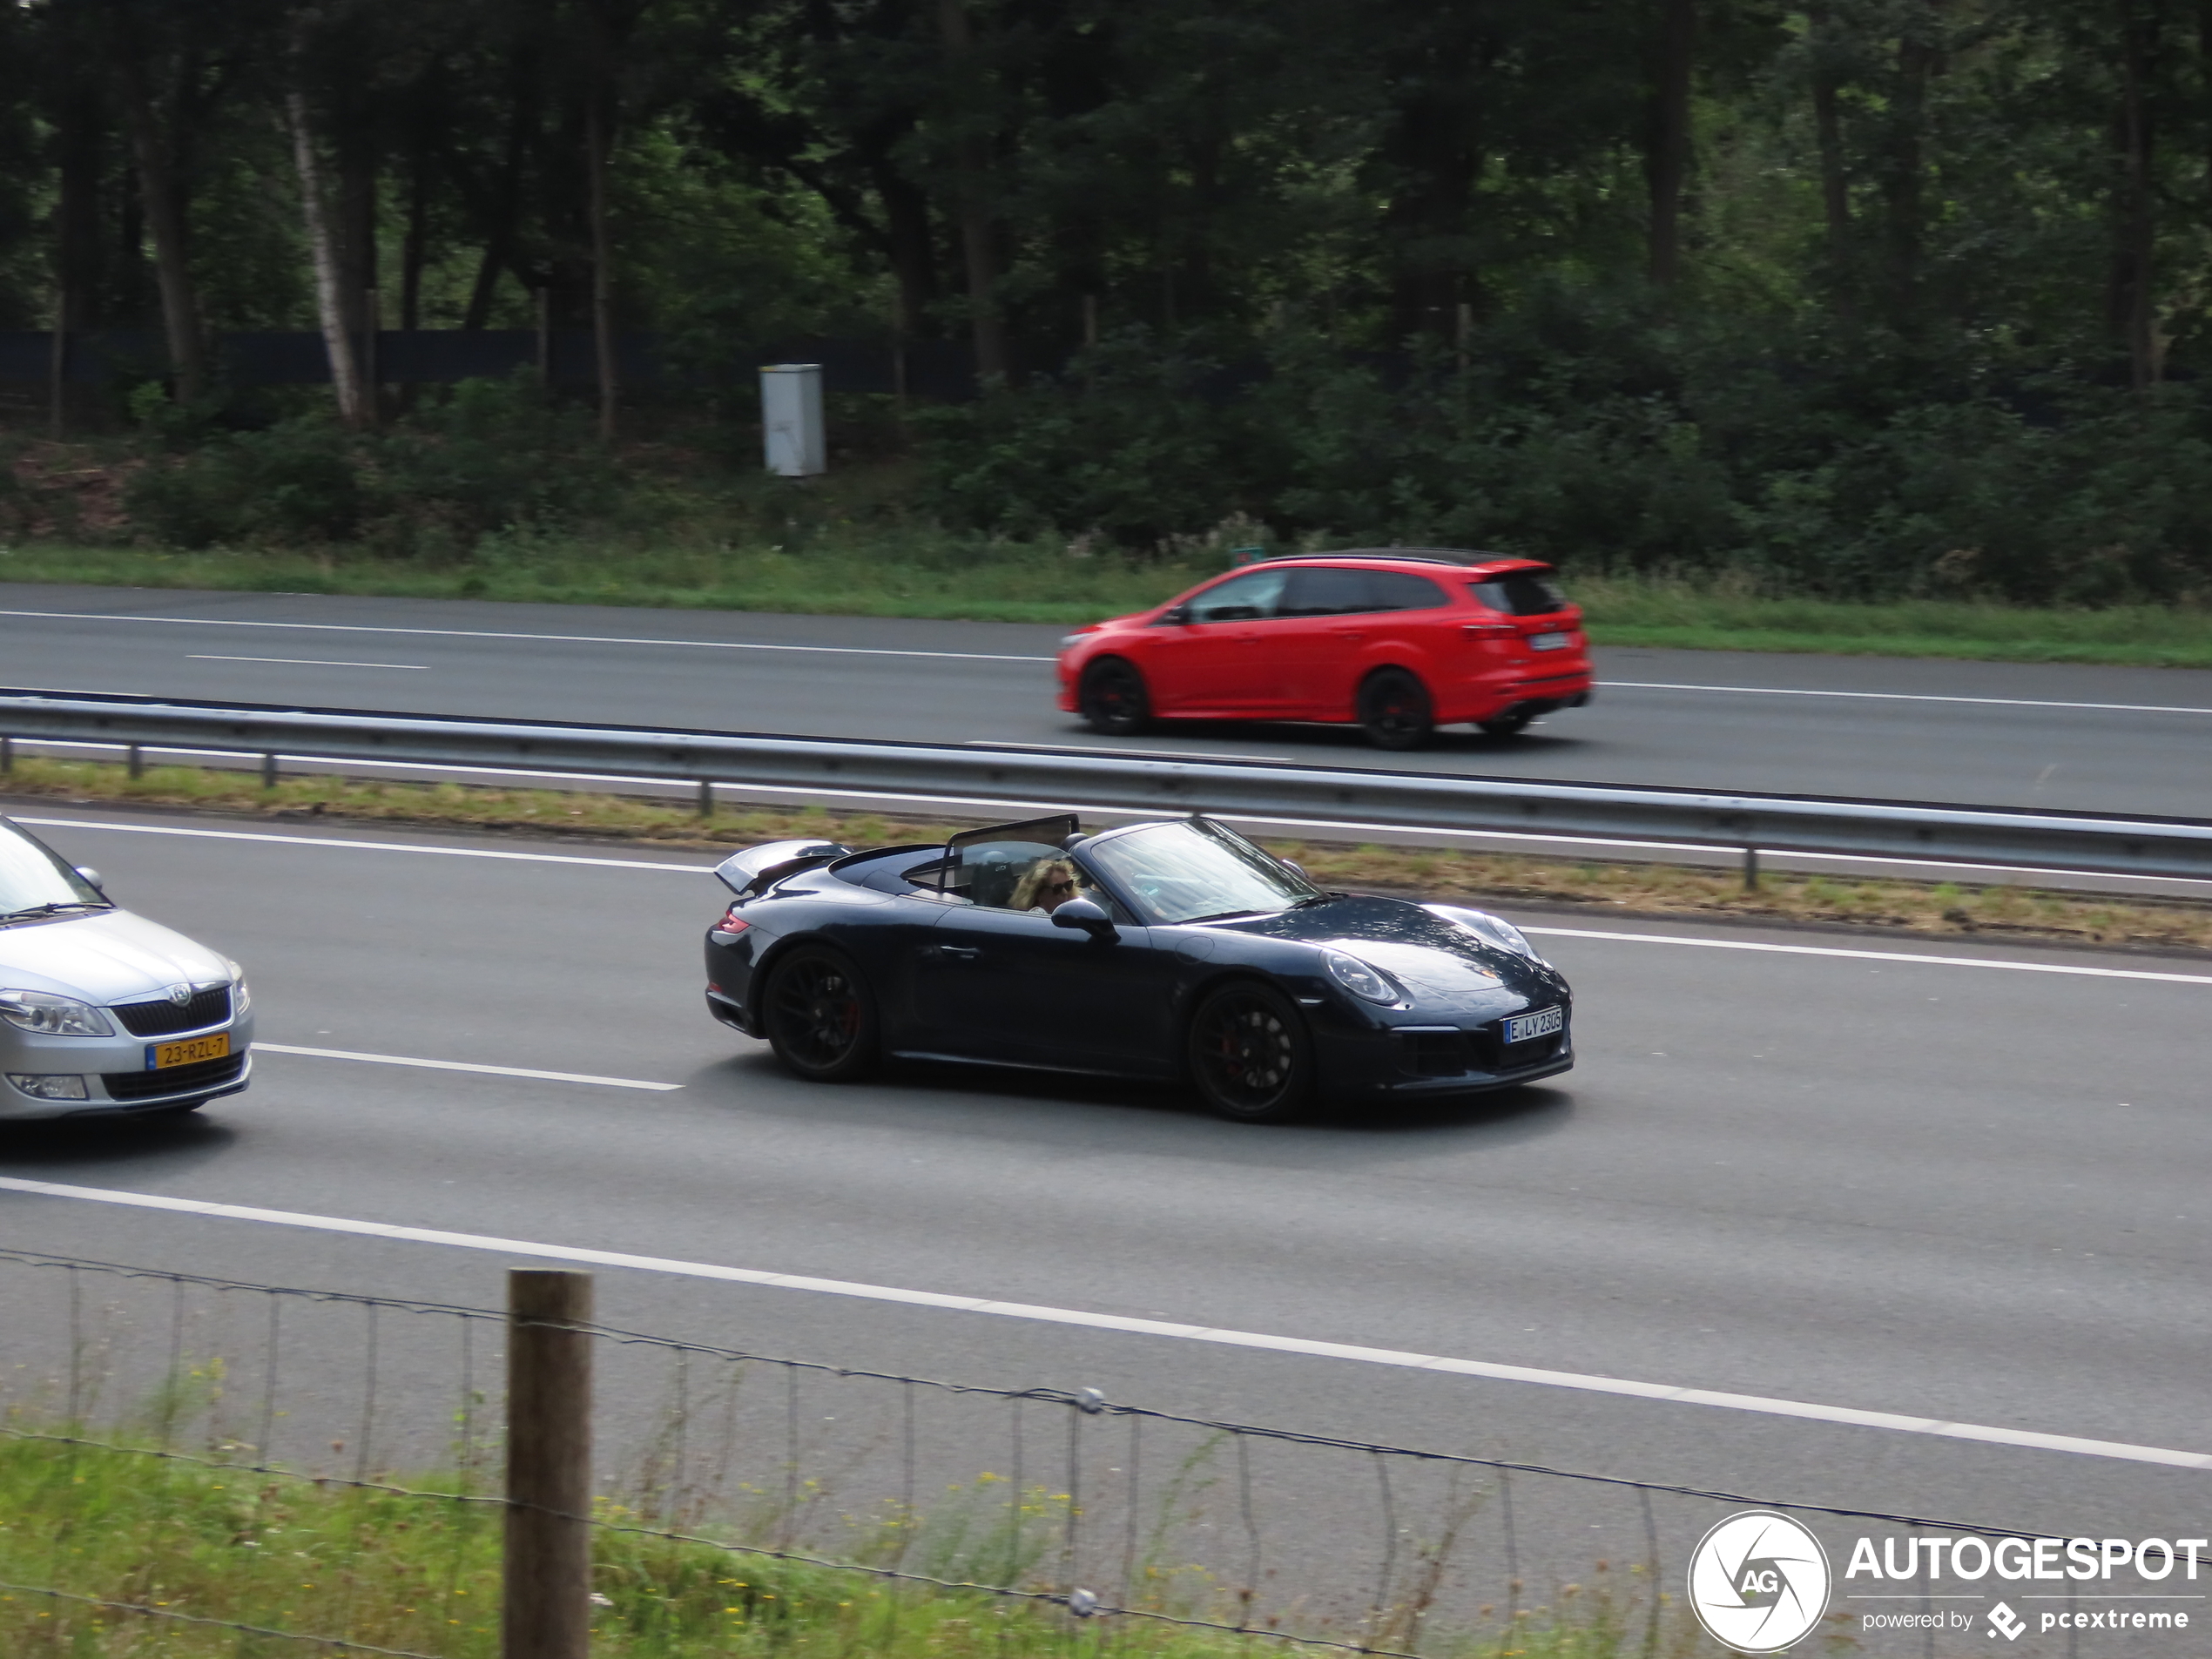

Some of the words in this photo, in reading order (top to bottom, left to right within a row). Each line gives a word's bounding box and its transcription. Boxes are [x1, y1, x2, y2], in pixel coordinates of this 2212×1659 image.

[1511, 1022, 1519, 1040] E
[1525, 1016, 1539, 1036] LY
[1540, 1010, 1561, 1034] 2305
[165, 1037, 224, 1064] 23-RZL-7
